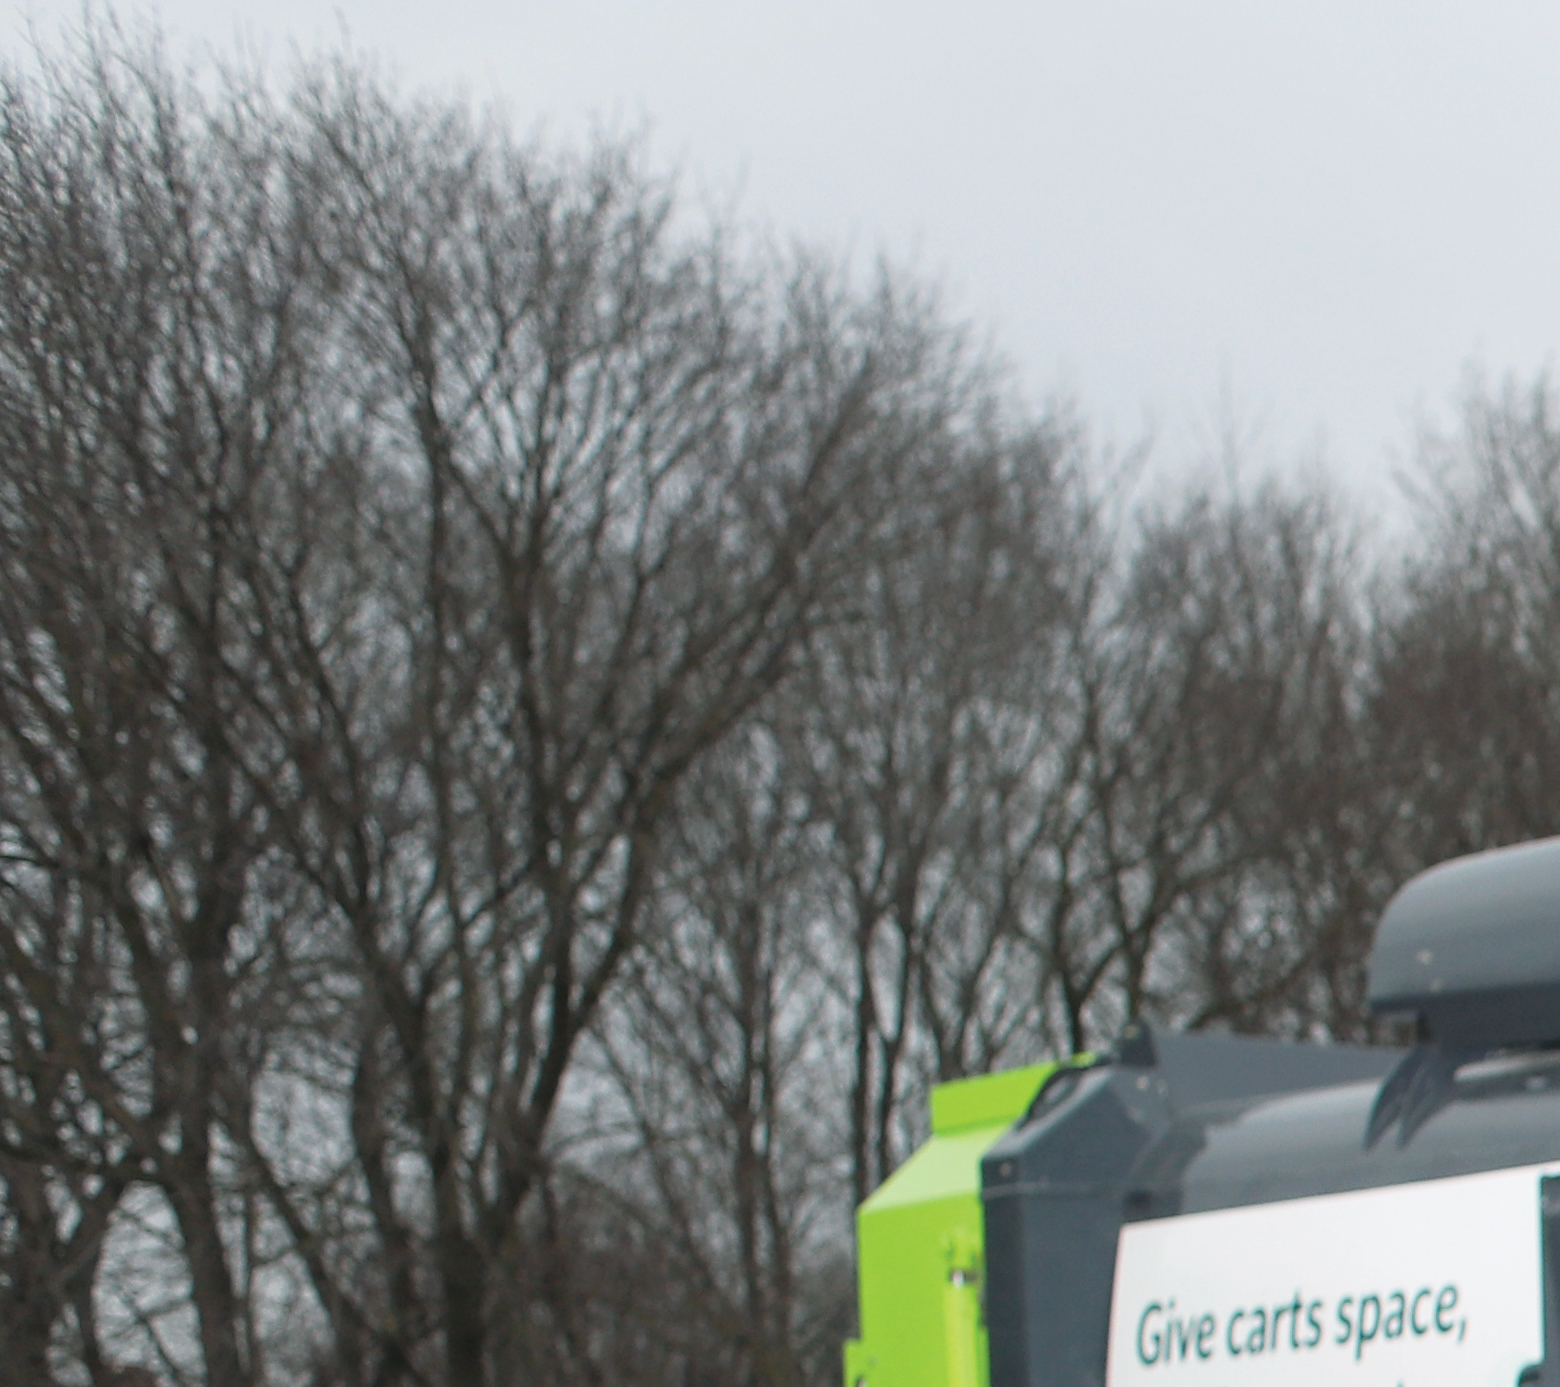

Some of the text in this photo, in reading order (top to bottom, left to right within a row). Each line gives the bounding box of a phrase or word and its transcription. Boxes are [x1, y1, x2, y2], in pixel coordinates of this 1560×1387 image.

[1136, 1282, 1468, 1367] Give carts space,
